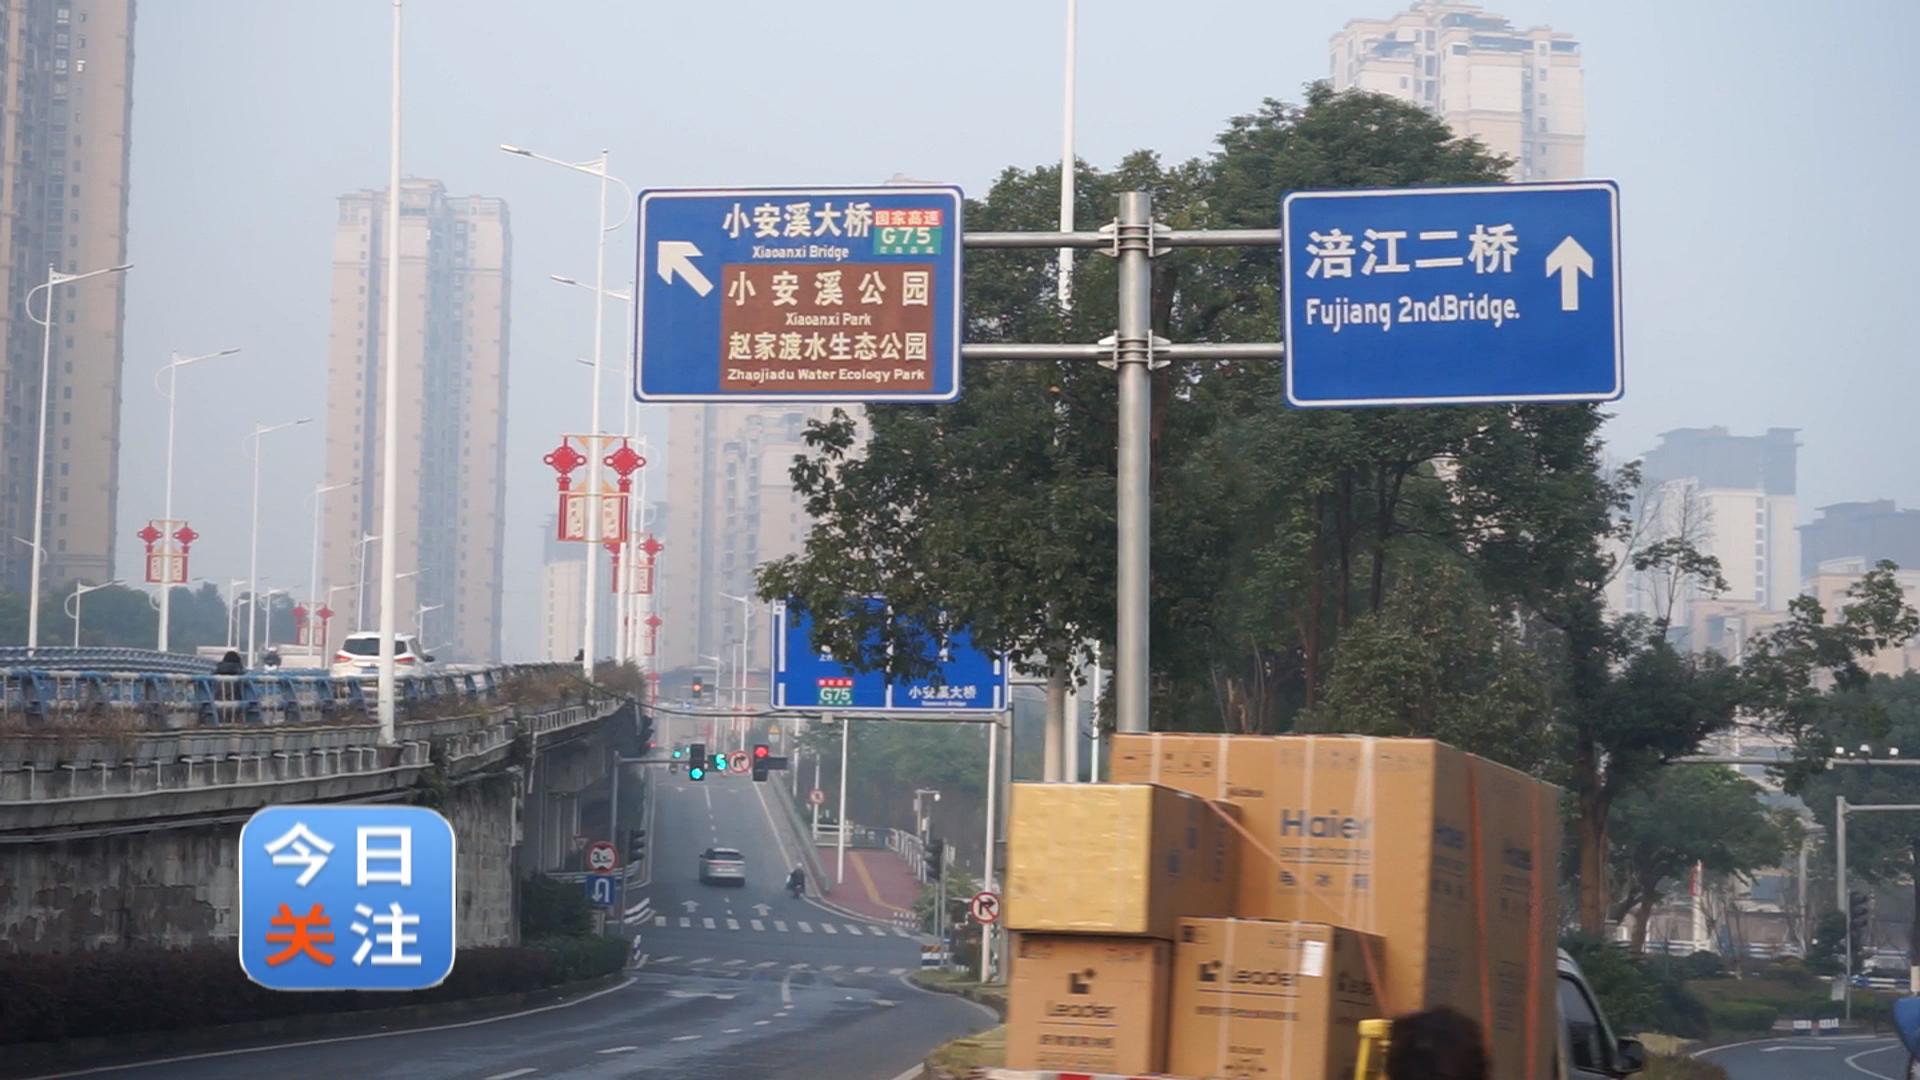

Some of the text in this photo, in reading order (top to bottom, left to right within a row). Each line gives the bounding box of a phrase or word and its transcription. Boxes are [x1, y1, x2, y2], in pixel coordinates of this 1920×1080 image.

[722, 202, 873, 238] 小安溪大桥
[881, 227, 931, 244] G75
[752, 245, 850, 261] Xiaoanxi Bridge
[1305, 223, 1519, 279] 涪江二桥
[728, 270, 930, 306] 小安溪公园
[785, 312, 872, 326] Xiaoanxi Park
[1306, 297, 1391, 333] Fujiang
[728, 331, 927, 361] 赵家渡水生态公园
[727, 368, 925, 384] Zhaojiadu Water Ecology Park
[820, 687, 850, 701] G75
